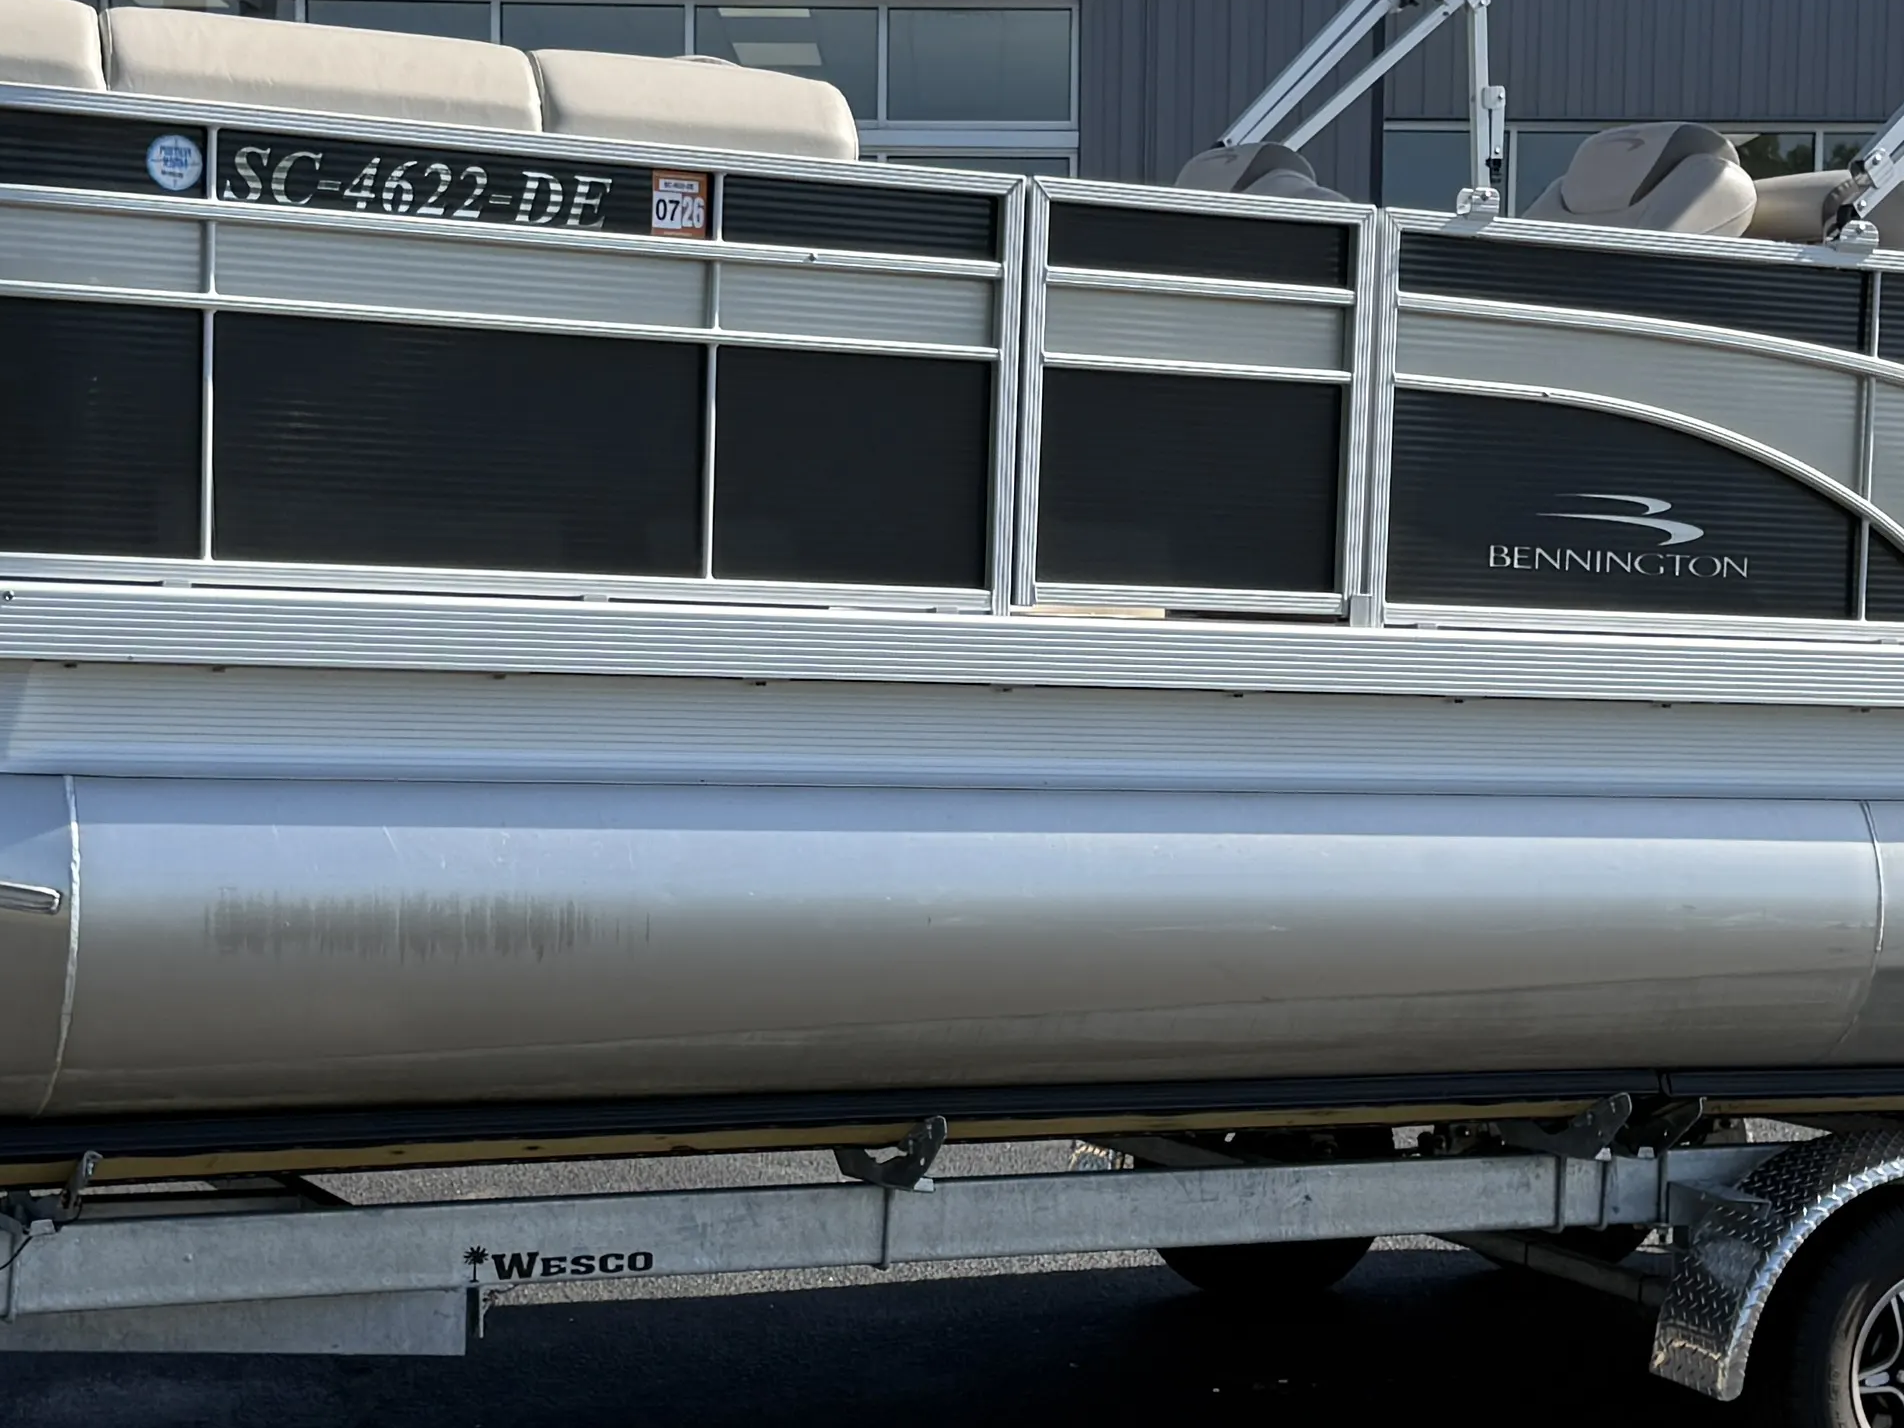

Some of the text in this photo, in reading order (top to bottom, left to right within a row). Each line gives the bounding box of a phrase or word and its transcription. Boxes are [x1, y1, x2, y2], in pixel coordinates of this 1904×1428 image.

[655, 195, 705, 229] 07 26
[1488, 544, 1749, 579] BENNINGTON
[491, 1251, 654, 1281] WESCO
